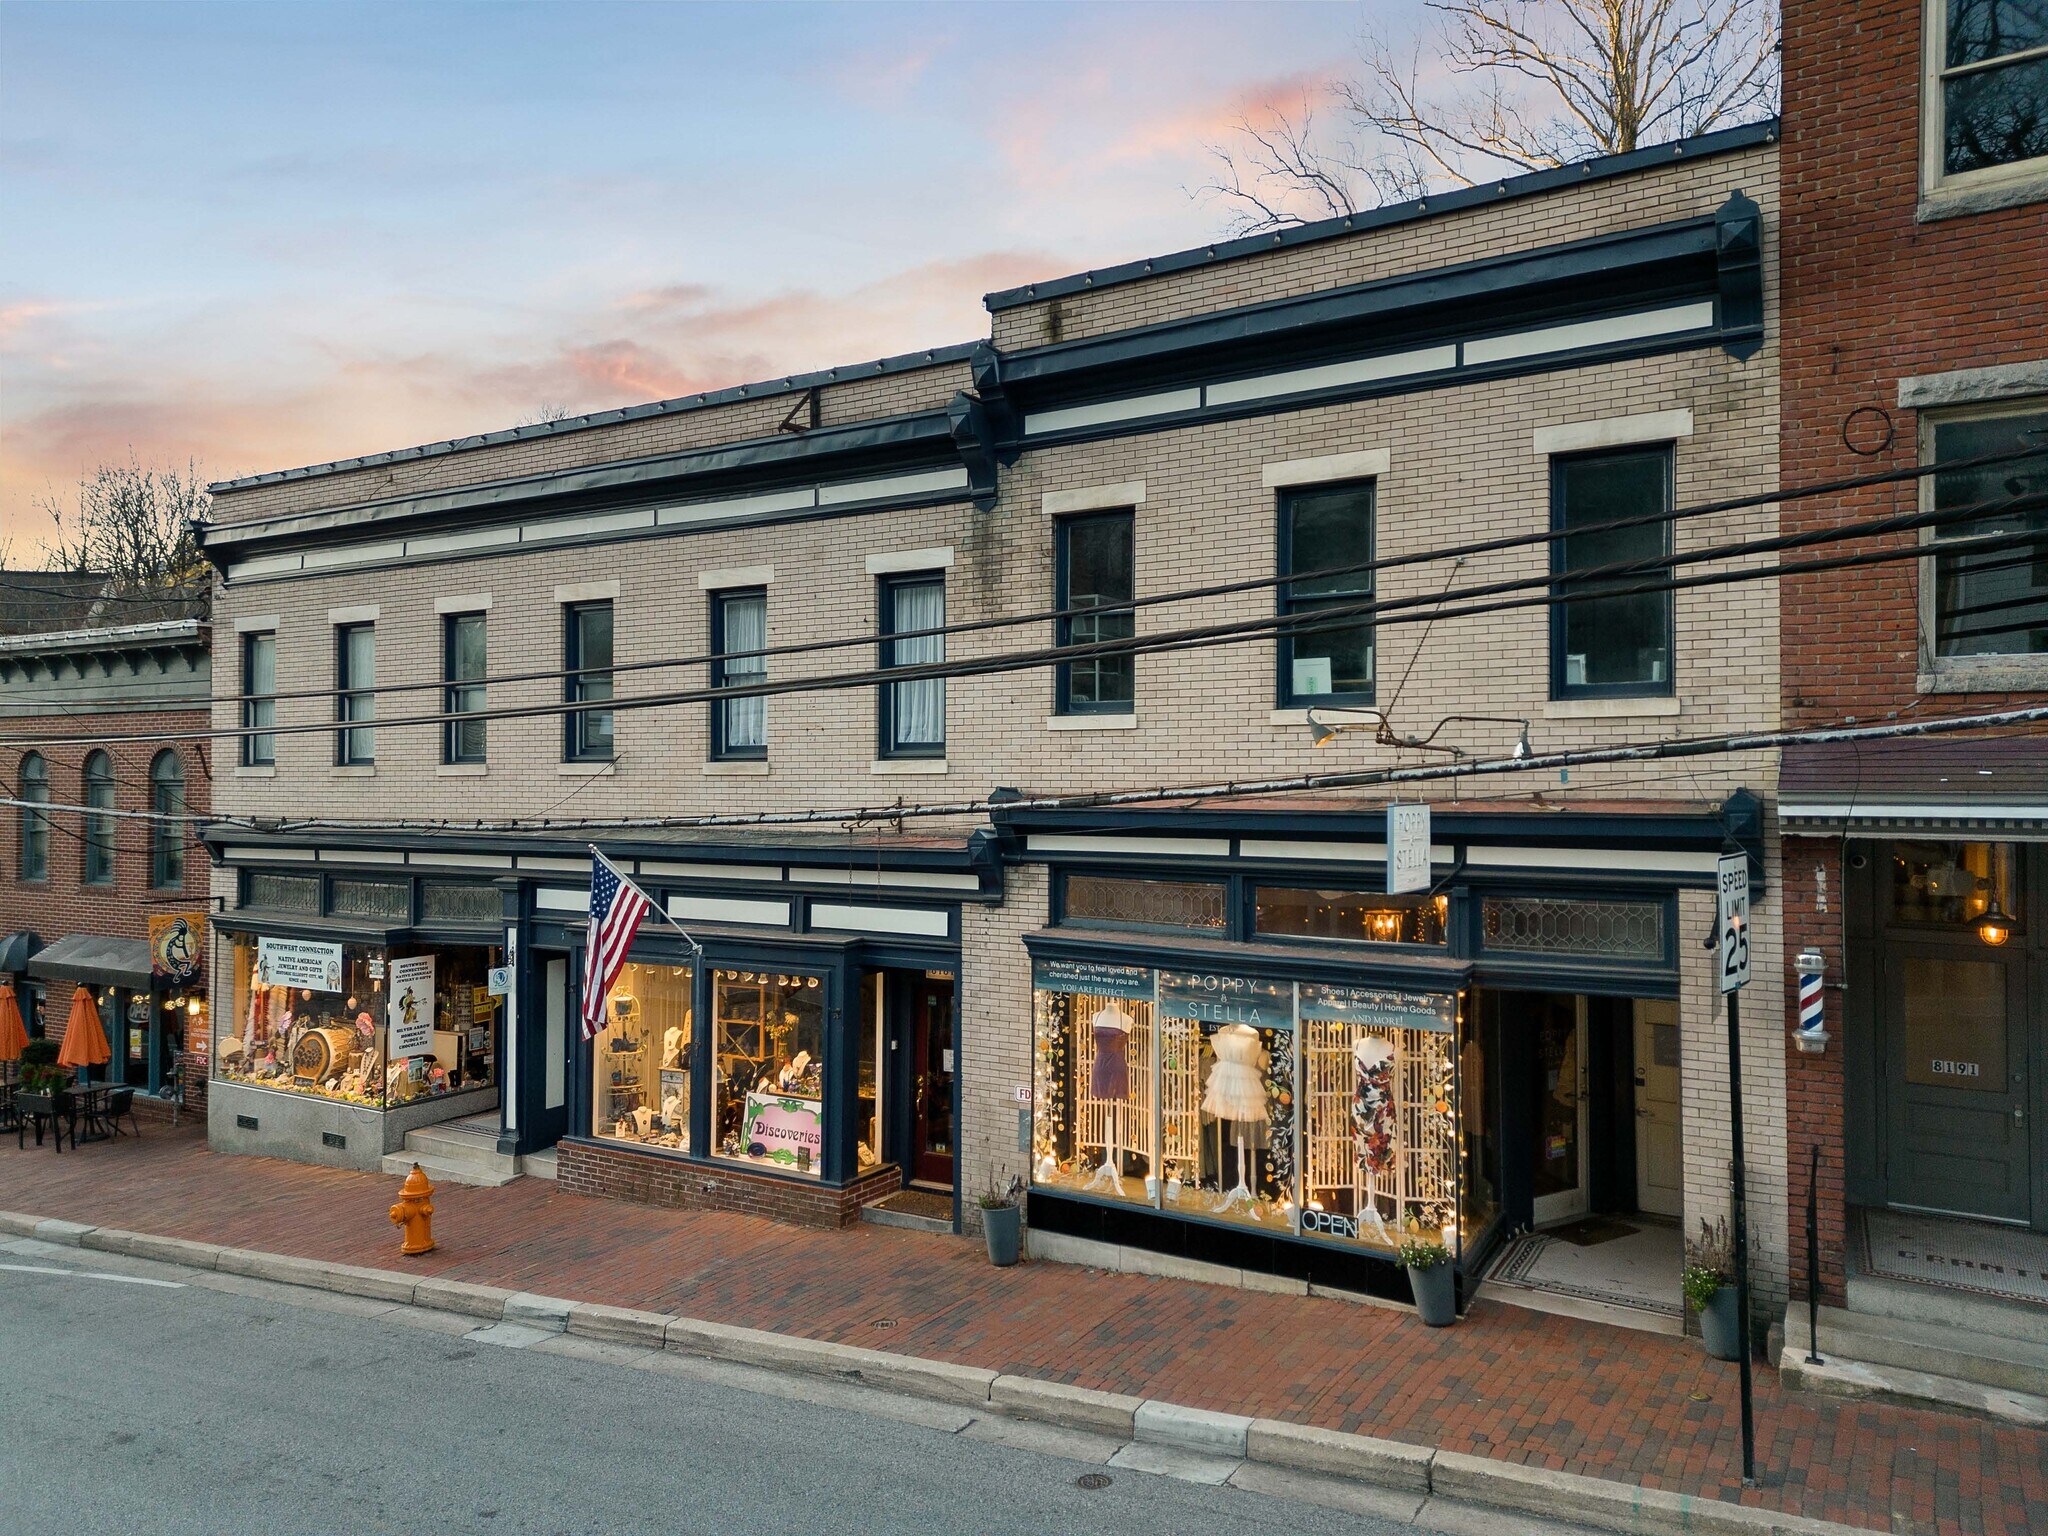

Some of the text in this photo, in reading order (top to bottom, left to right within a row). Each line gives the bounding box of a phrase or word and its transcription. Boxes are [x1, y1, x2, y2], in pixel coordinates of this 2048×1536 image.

[1398, 811, 1426, 832] POPPY
[1396, 849, 1428, 870] STELLA
[1722, 869, 1747, 894] SPEED
[1726, 896, 1746, 920] LIMIT
[266, 942, 334, 954] SOUTHWEST CONNECTION
[1725, 923, 1748, 977] 25
[278, 956, 322, 966] NATIVE AMERICAN
[400, 961, 428, 969] SOUTHWEST
[309, 966, 322, 974] GIFTS
[399, 966, 428, 974] CONNECTION
[1060, 962, 1075, 970] want
[1076, 964, 1087, 972] you
[1125, 968, 1138, 976] and
[1049, 971, 1078, 980] cherished
[1079, 974, 1090, 982] just
[1092, 974, 1101, 982] the
[1116, 978, 1127, 986] you
[1192, 974, 1257, 994] POPPY
[1062, 983, 1077, 992] YOU
[1094, 987, 1127, 997] PERFECT.
[1321, 986, 1345, 996] Shoes
[1350, 989, 1398, 1000] Accessories
[1402, 994, 1434, 1004] Jewelry
[1220, 994, 1228, 1002] &
[1188, 1002, 1261, 1024] STELLA
[1318, 998, 1347, 1008] Apparel
[1352, 1001, 1379, 1012] Beauty
[1385, 1004, 1408, 1013] Home
[1410, 1006, 1436, 1015] Goods
[1351, 1014, 1403, 1026] AND MORE!
[400, 1030, 426, 1039] HOMEMADE
[398, 1040, 428, 1050] CHOCOLATES
[196, 1056, 206, 1065] FDC
[1933, 1060, 1978, 1076] 8191
[755, 1121, 820, 1144] Discoveries
[1302, 1210, 1357, 1239] OPEN
[1898, 1249, 2048, 1281] GRANT
